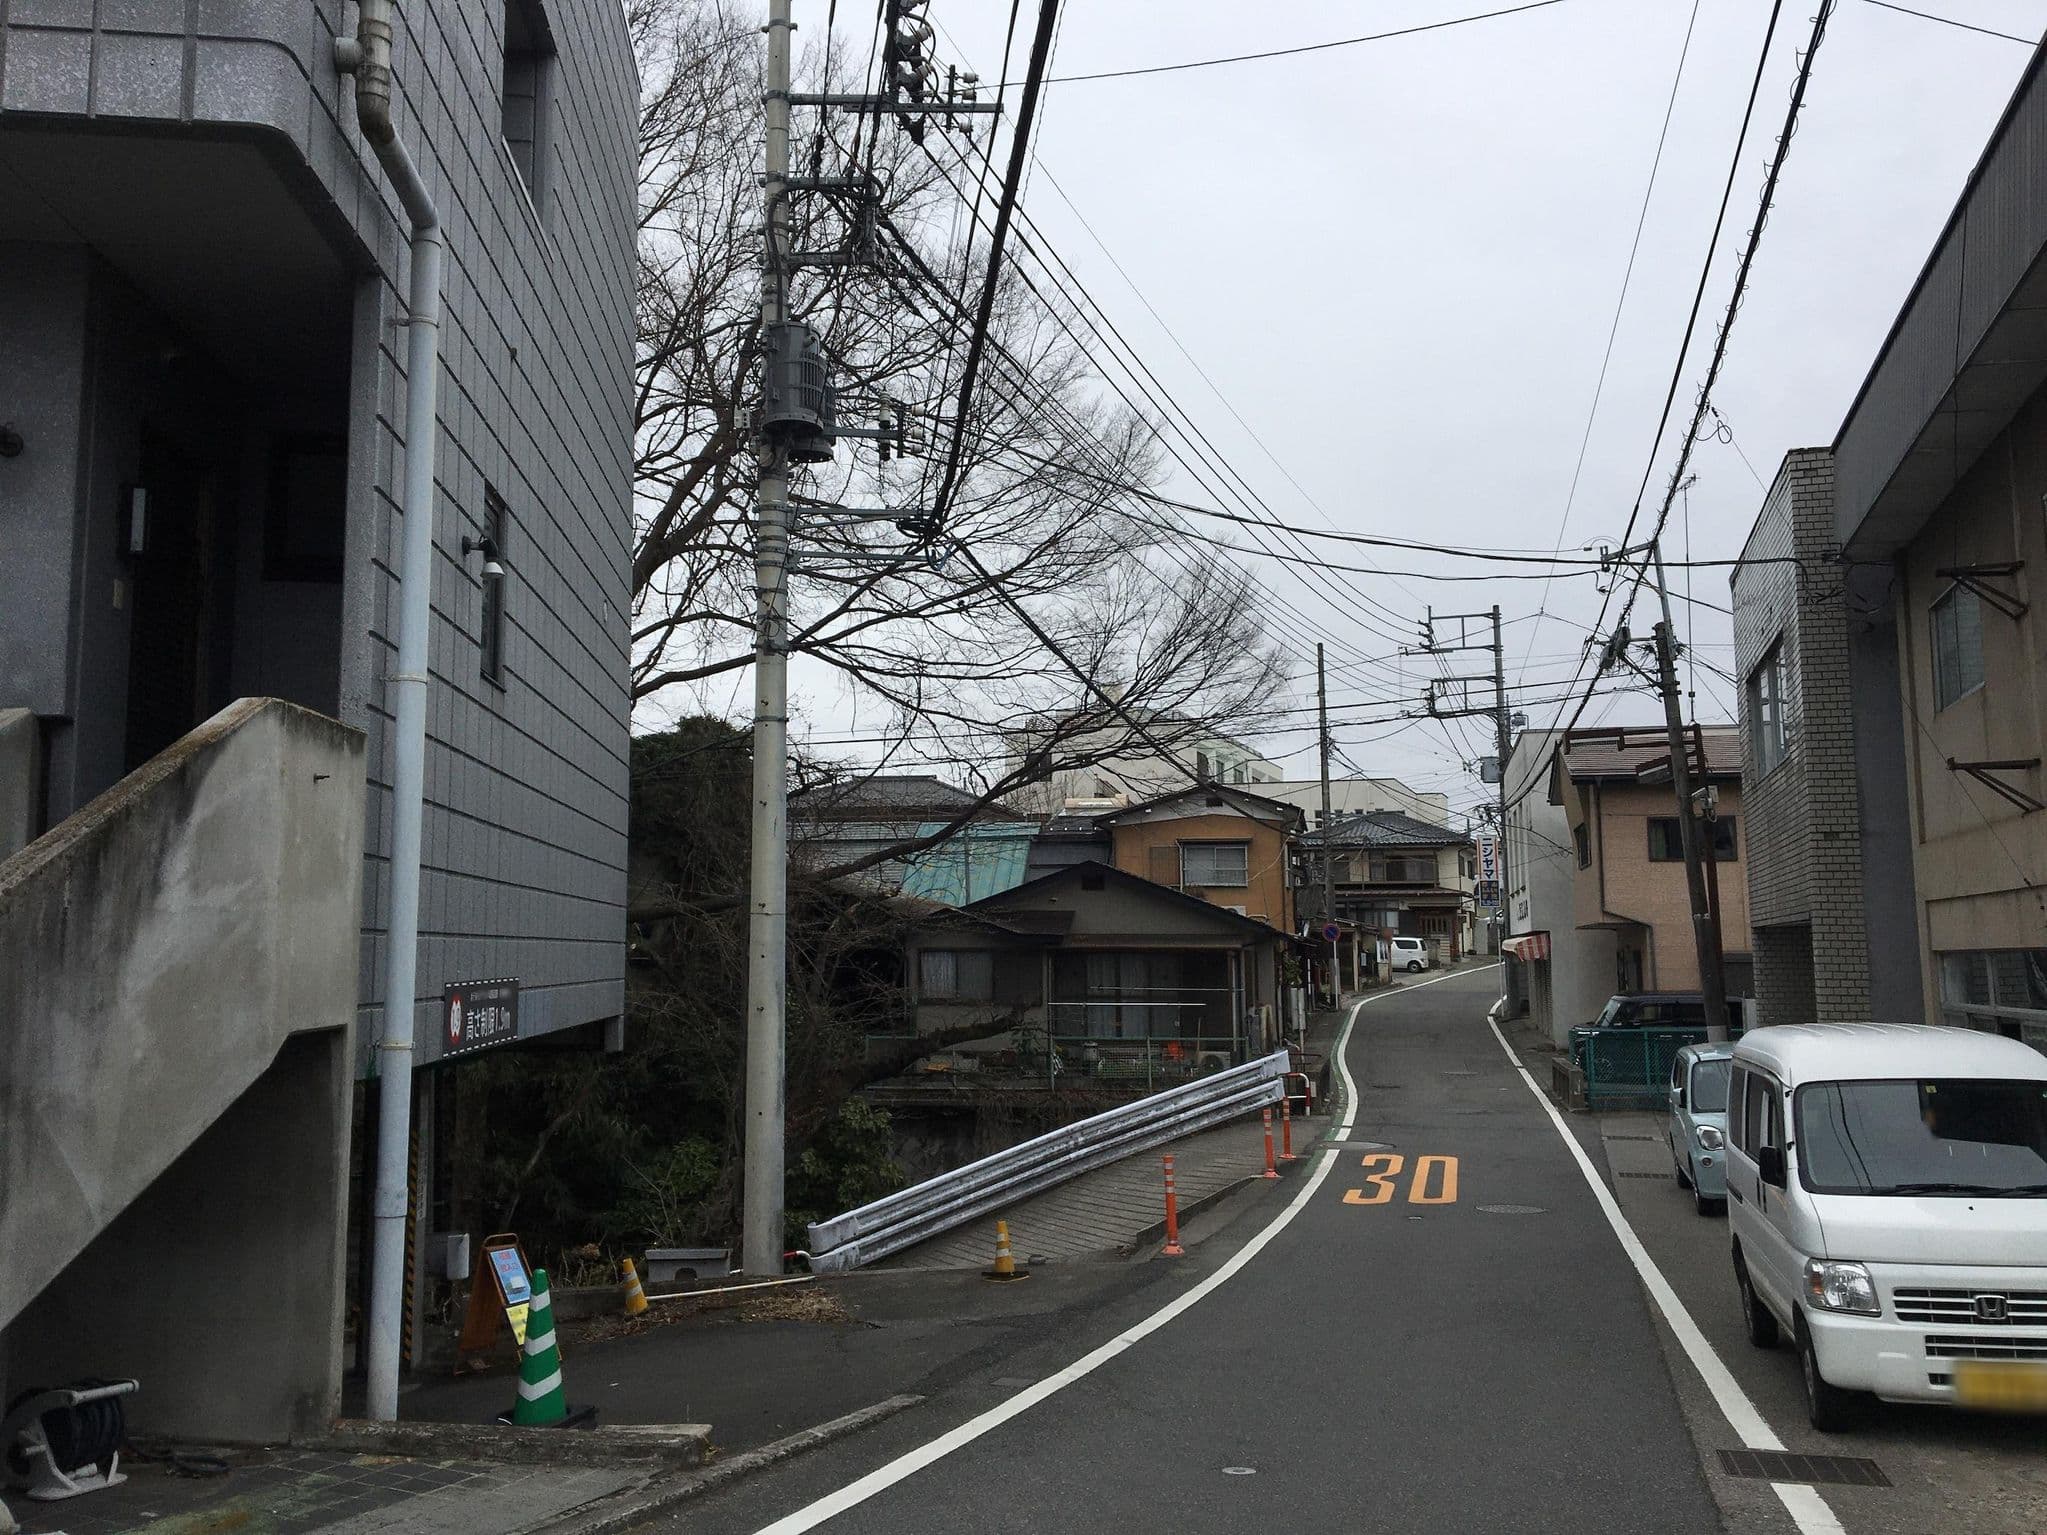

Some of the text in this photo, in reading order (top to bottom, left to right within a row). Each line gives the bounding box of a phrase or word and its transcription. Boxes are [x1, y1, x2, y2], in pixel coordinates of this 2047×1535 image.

[1482, 837, 1494, 879] ニシヤマ
[1342, 1154, 1459, 1204] 30
